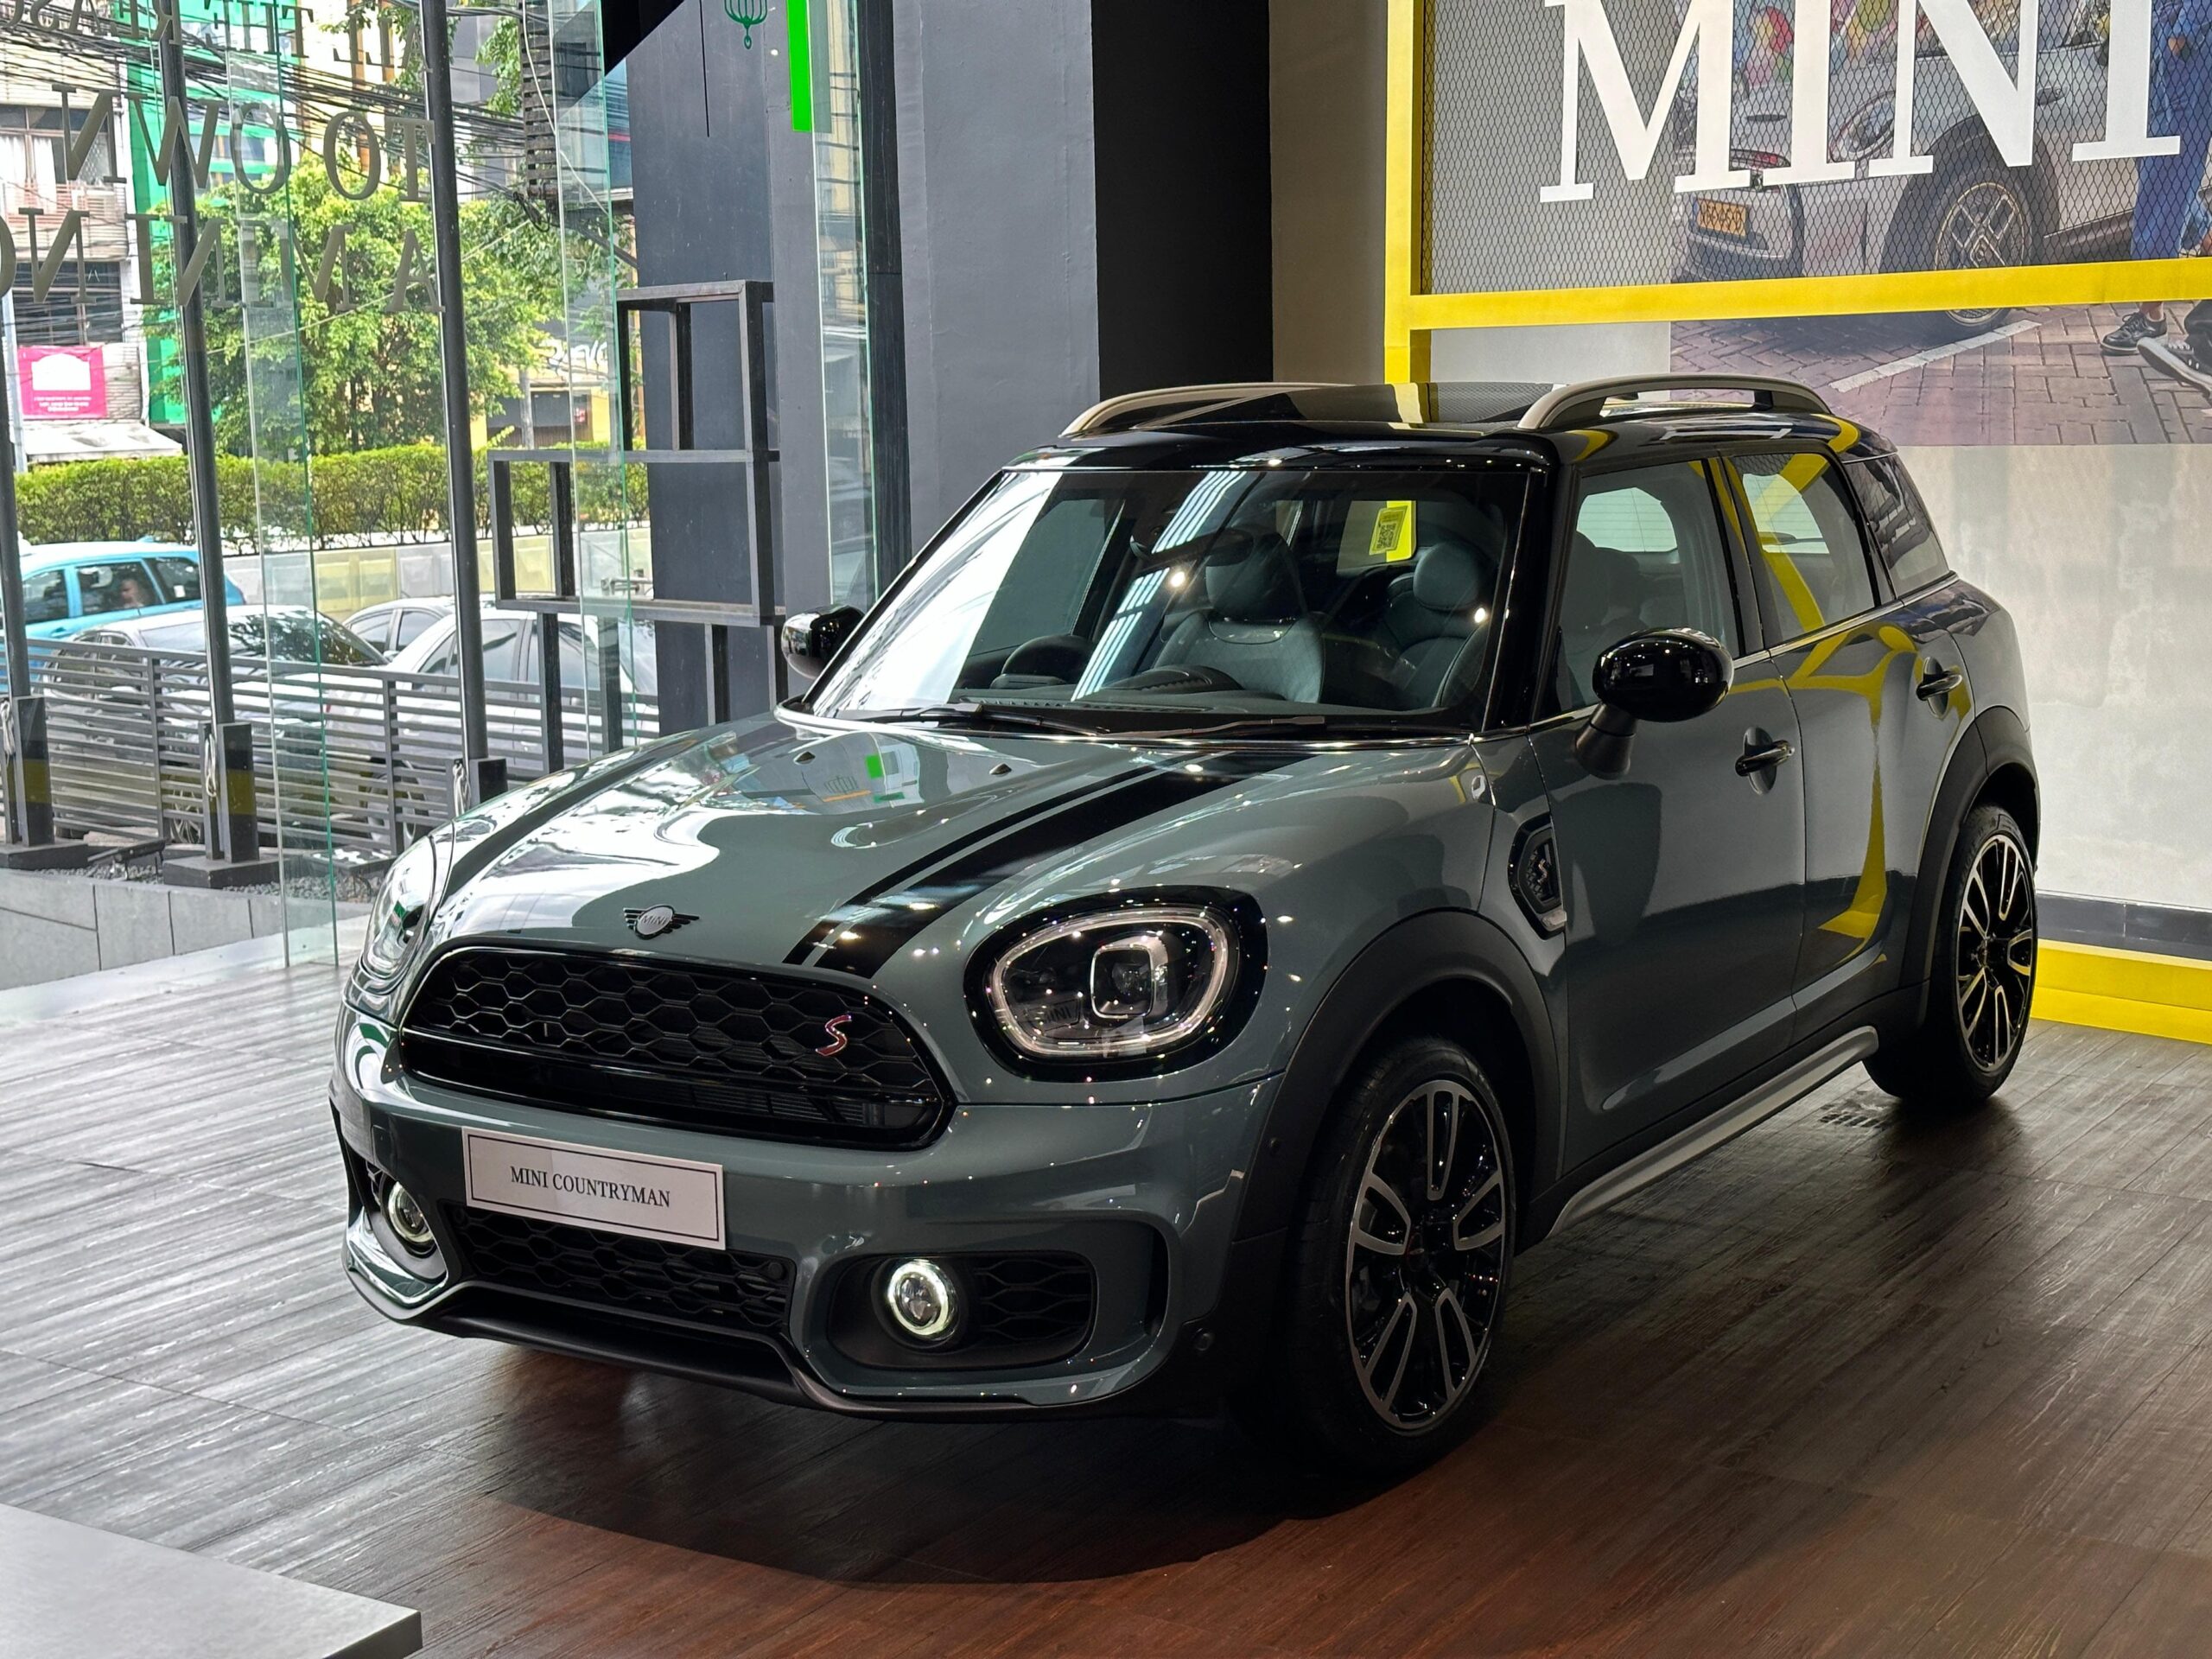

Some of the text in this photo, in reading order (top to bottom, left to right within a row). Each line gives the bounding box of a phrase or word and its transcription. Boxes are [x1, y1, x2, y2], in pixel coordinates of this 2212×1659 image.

[1540, 0, 2181, 204] MINI
[641, 915, 668, 926] MINI
[815, 1014, 853, 1057] S
[510, 1166, 671, 1208] MINI COUNTRYMAN
